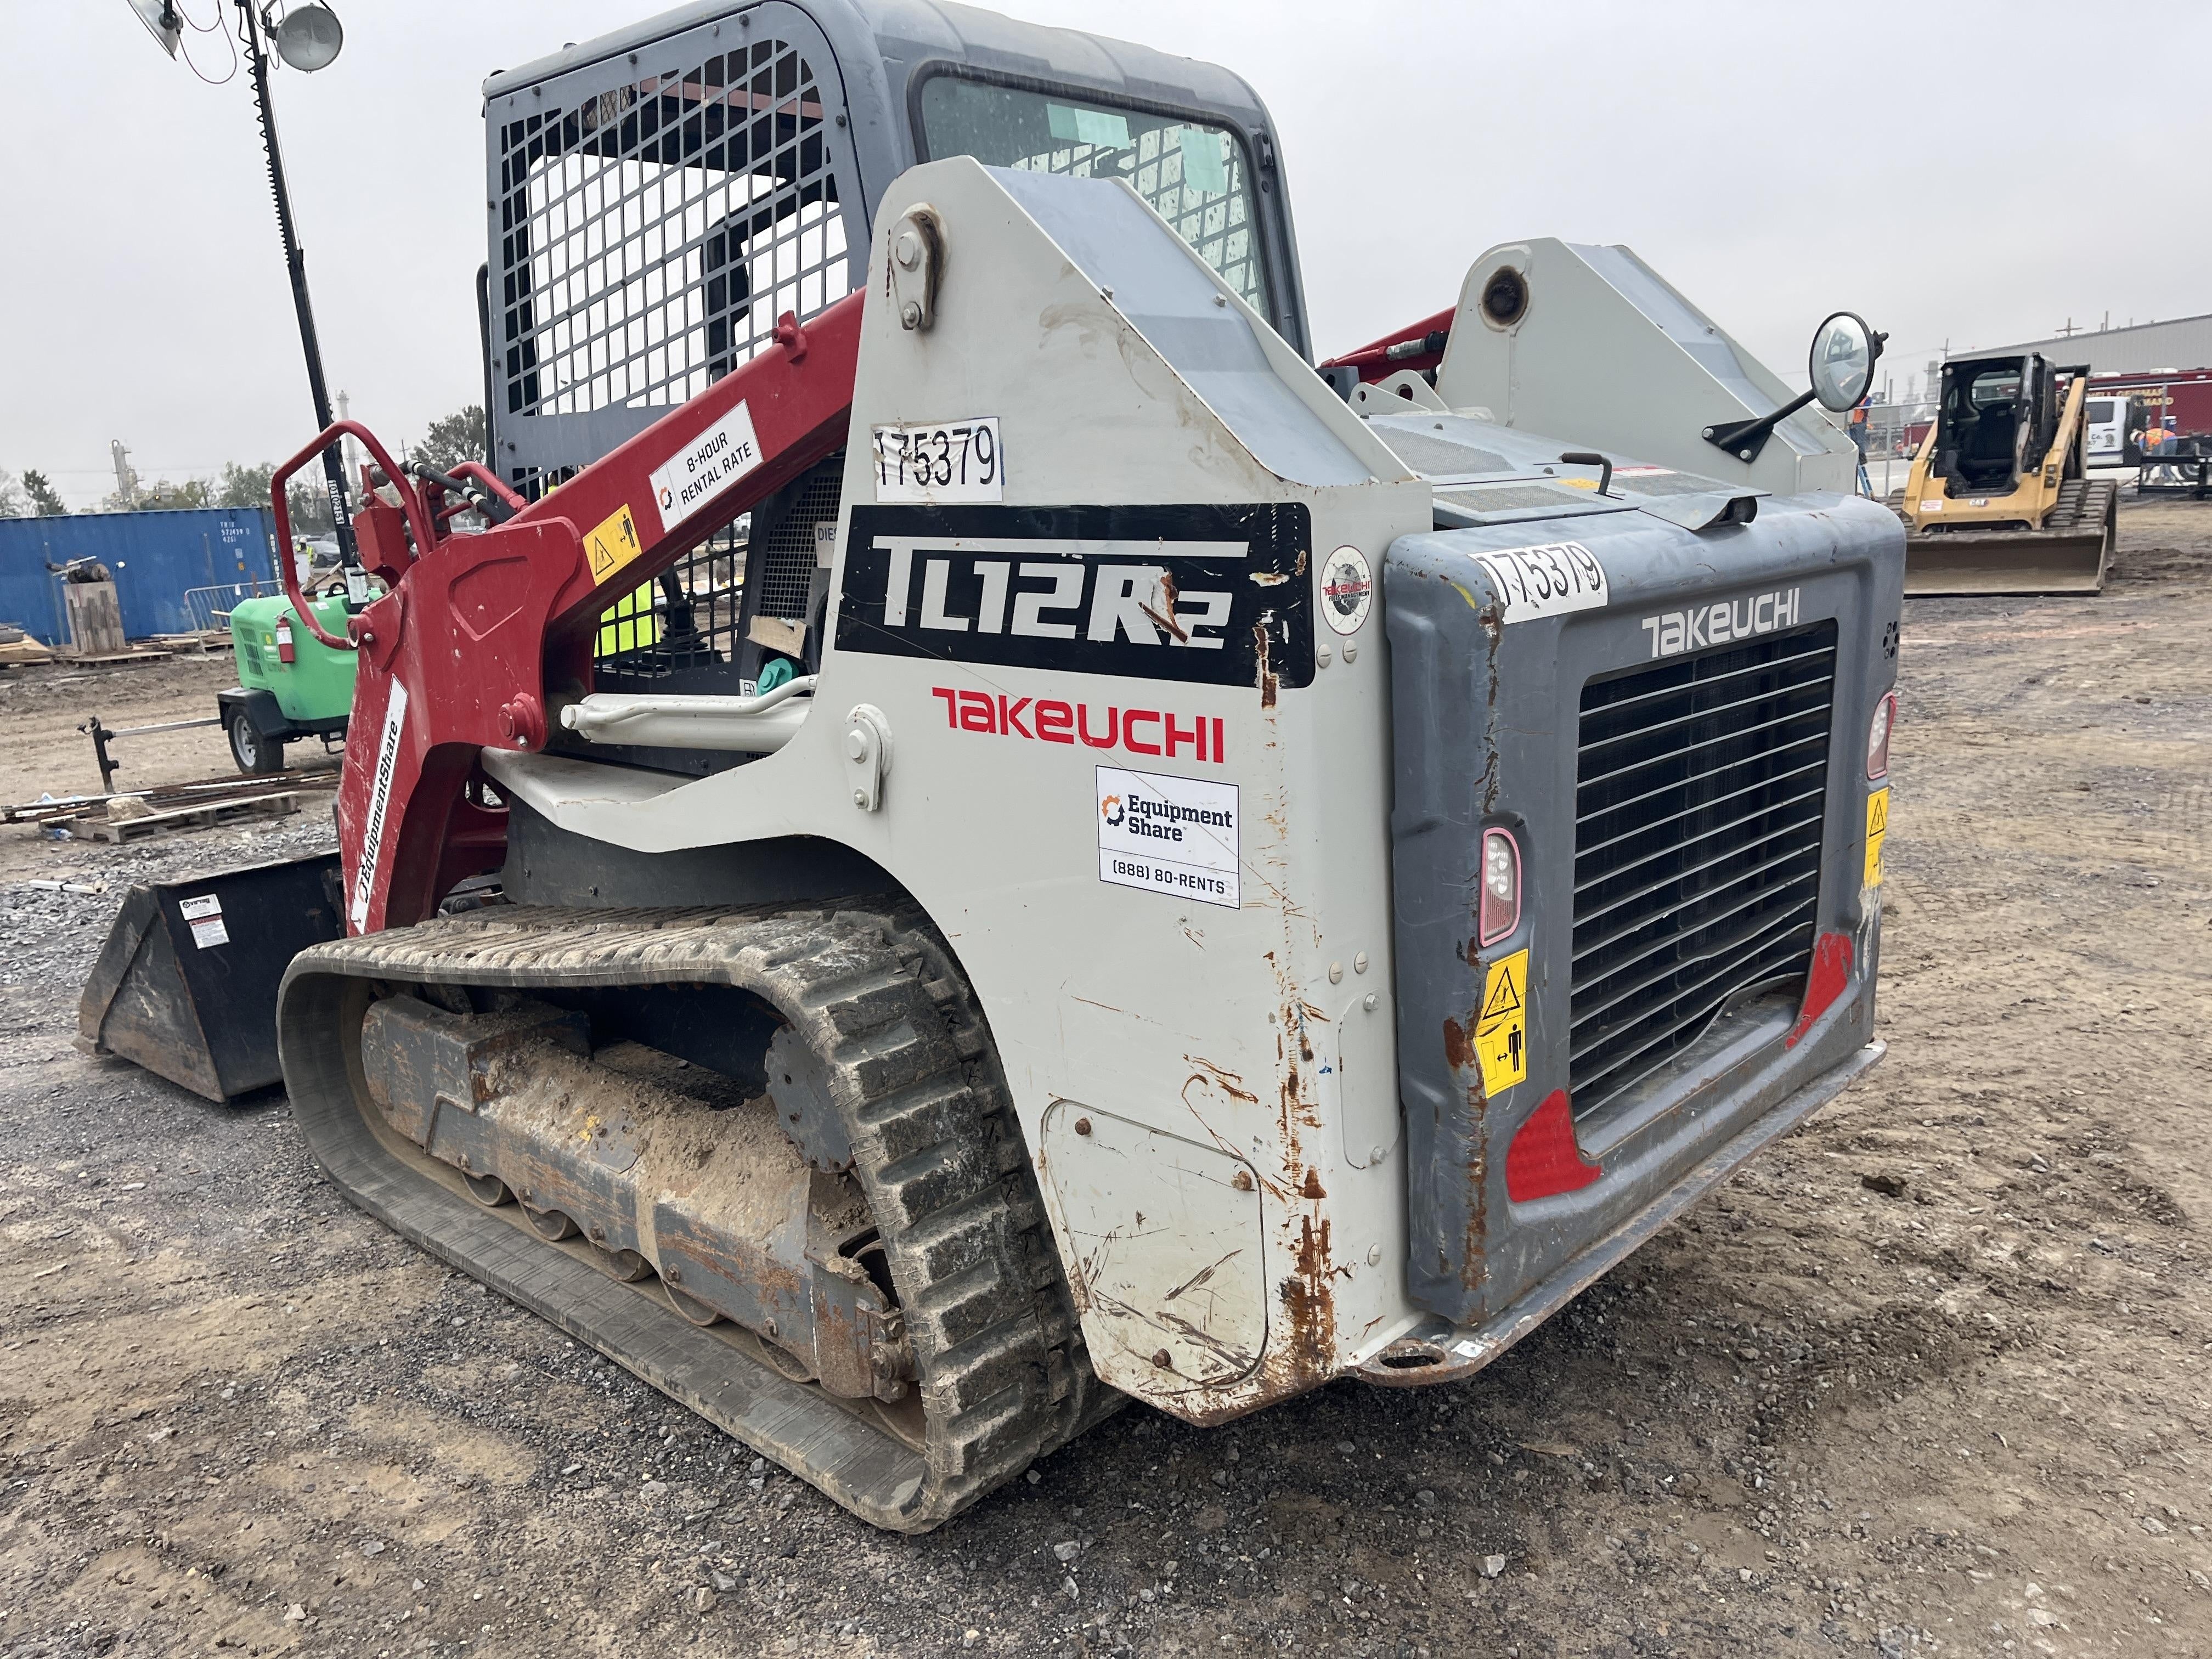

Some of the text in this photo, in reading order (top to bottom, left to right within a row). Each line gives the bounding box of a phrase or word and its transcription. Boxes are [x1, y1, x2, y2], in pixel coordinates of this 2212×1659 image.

[681, 441, 752, 505] RENTAL RATE
[686, 432, 728, 473] 8-HOUR
[874, 425, 995, 486] 175379
[872, 535, 1252, 650] TL12R2
[1476, 544, 1601, 605] 175379
[1641, 587, 1800, 658] TAKEUCHI
[932, 687, 1224, 764] TAKEUCHI
[361, 720, 398, 883] EquipmentShare
[1128, 794, 1233, 828] Equipment
[1128, 816, 1183, 842] Share
[1113, 859, 1225, 894] (888) 80-RENTS
